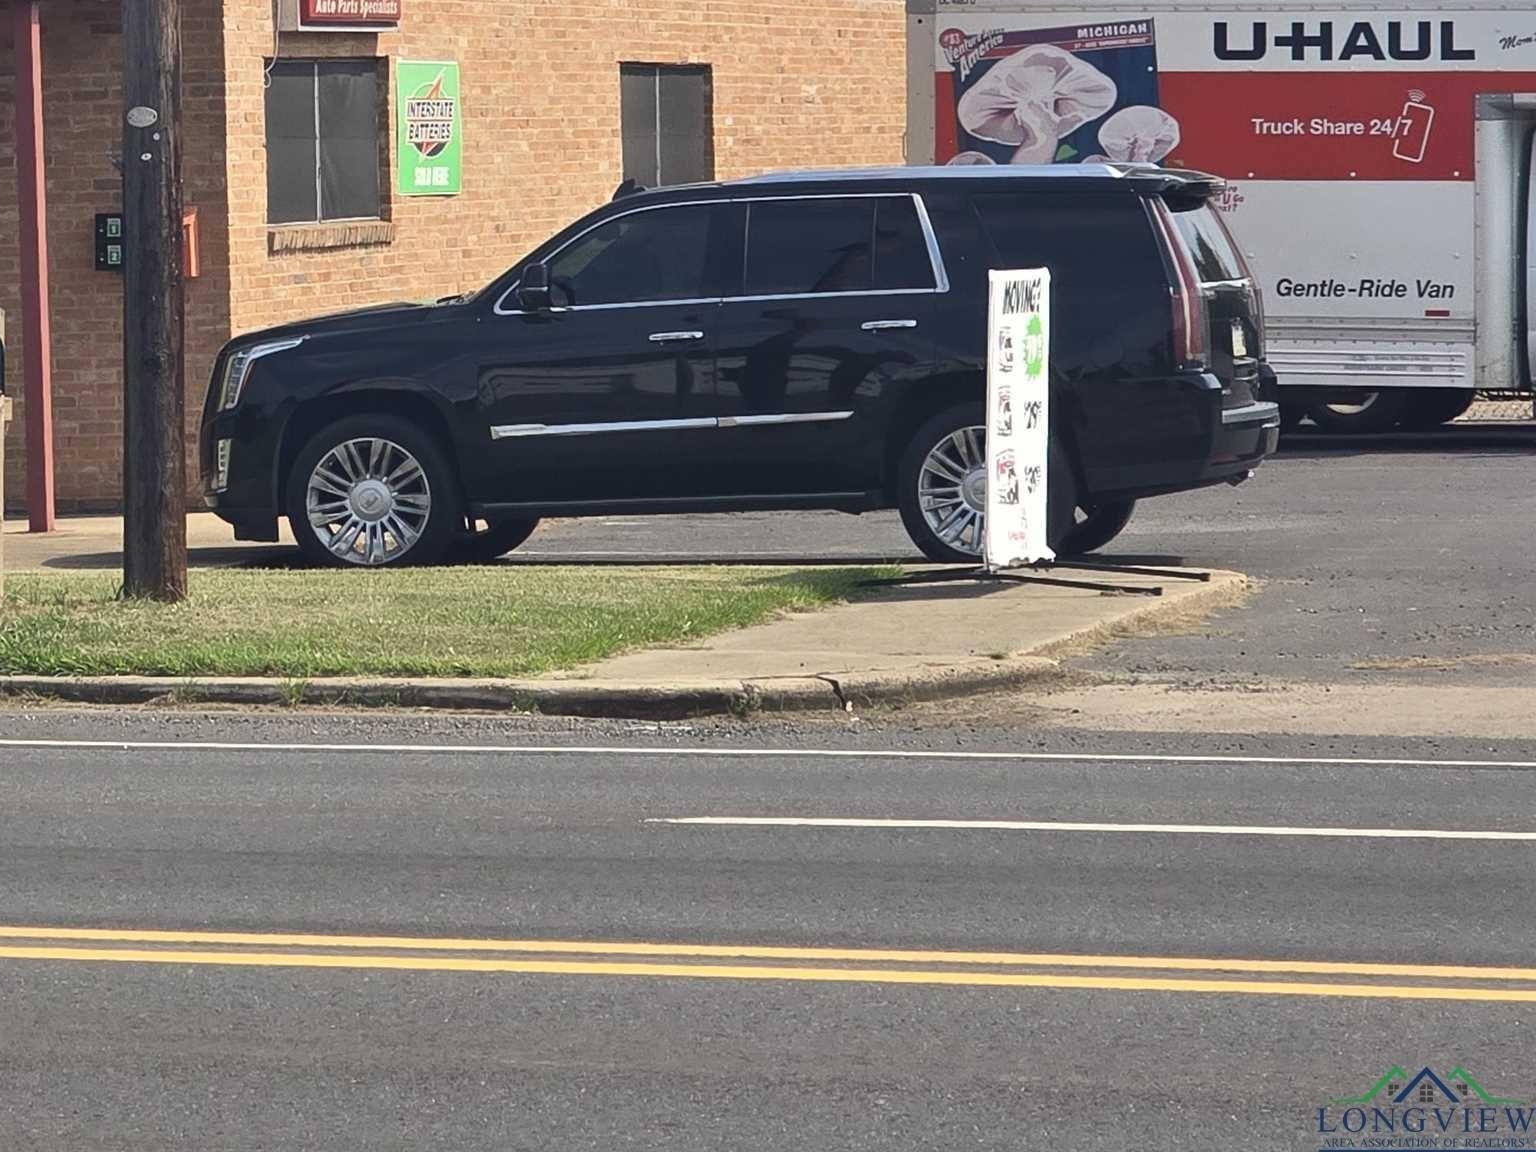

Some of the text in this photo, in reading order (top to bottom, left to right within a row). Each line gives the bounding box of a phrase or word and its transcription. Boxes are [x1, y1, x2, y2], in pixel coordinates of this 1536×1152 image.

[1077, 23, 1147, 39] MICHIGAN
[1214, 21, 1476, 61] U-HAUL
[407, 101, 454, 118] INTERSTATE
[408, 123, 451, 140] BATTERIES
[1251, 115, 1413, 139] Truck Share 24/7
[1276, 278, 1455, 299] Gentle-Ride Van
